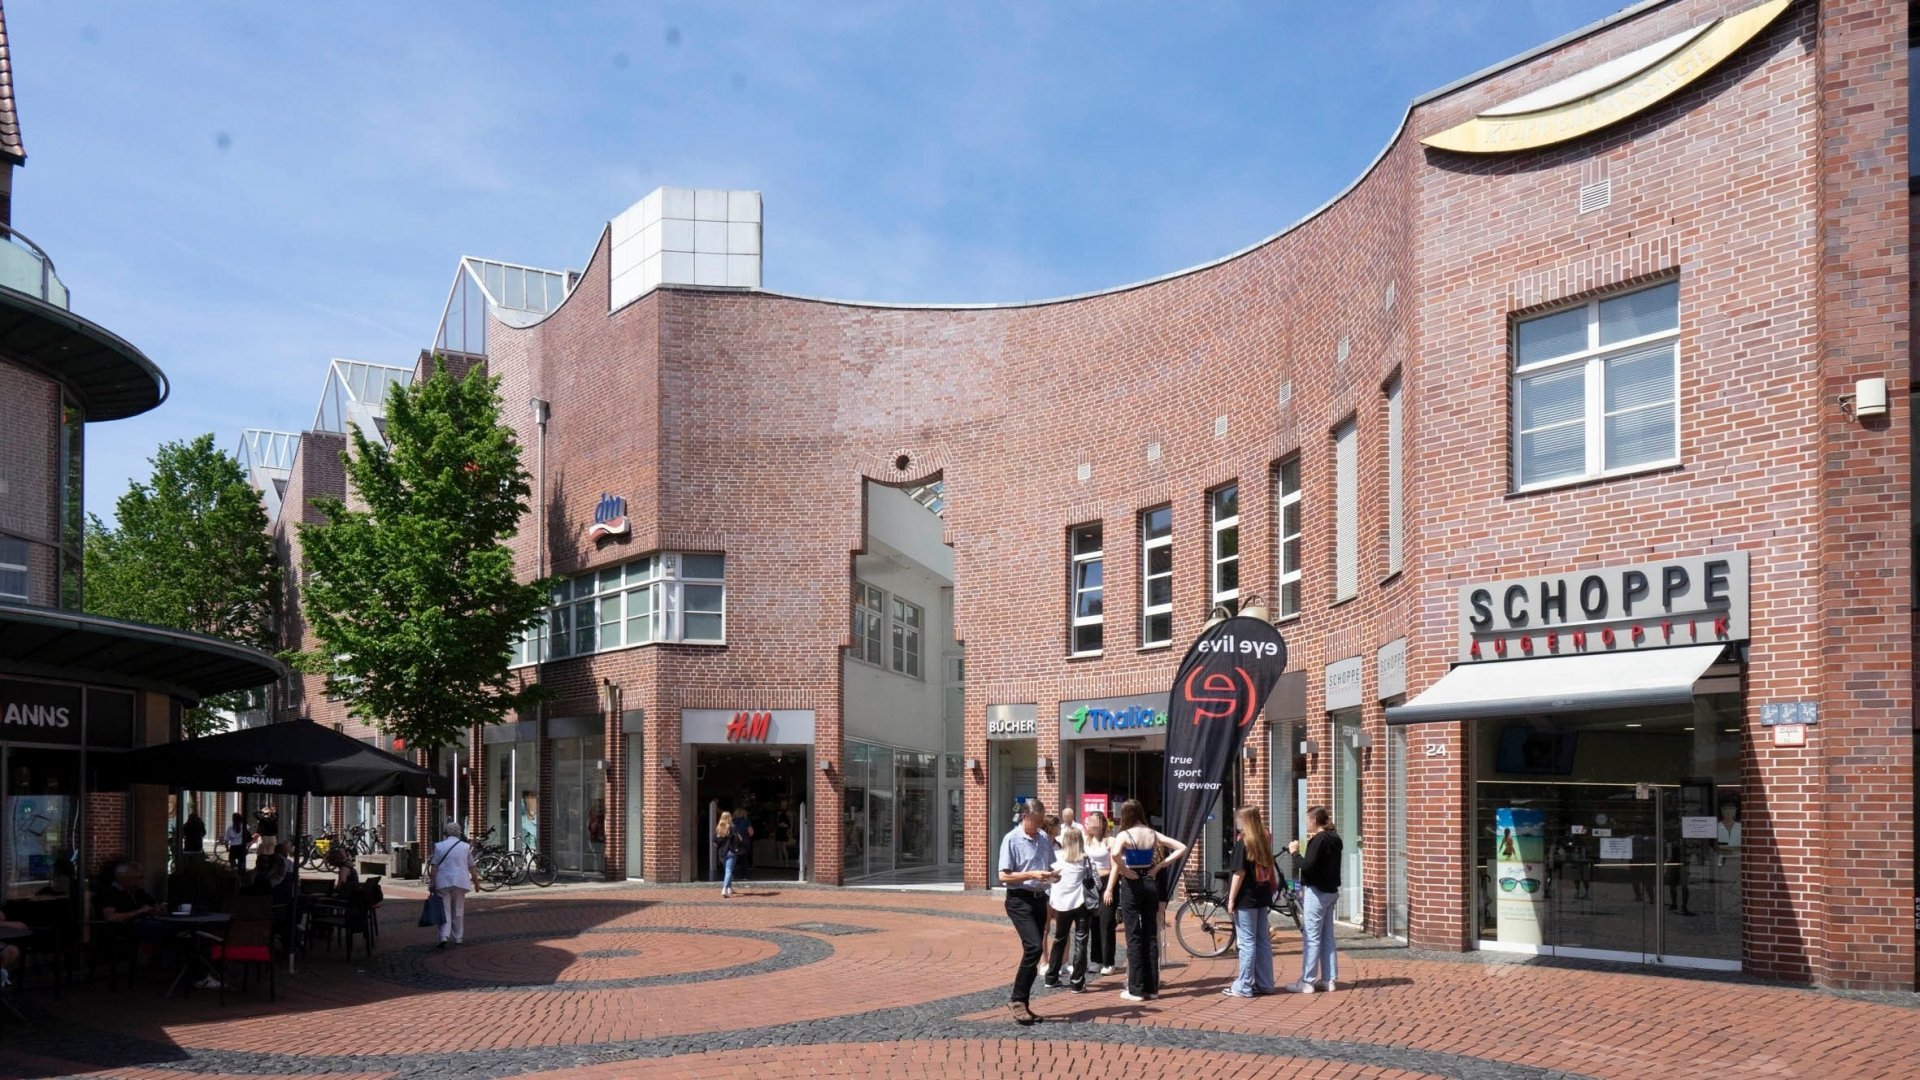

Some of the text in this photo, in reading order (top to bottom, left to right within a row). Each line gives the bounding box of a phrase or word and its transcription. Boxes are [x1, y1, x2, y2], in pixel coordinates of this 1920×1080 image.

[1470, 559, 1730, 627] SCHOPPE
[1470, 617, 1728, 656] AUGENOPTIK
[1198, 635, 1234, 653] evil
[1329, 668, 1360, 687] SCHOPPE
[727, 710, 772, 742] H&M
[989, 719, 1034, 732] BÜCHER
[1426, 744, 1445, 756] 24
[1170, 756, 1193, 764] true
[1173, 769, 1202, 778] sport
[236, 776, 282, 786] ESSMANNS
[1178, 782, 1221, 791] eyewear
